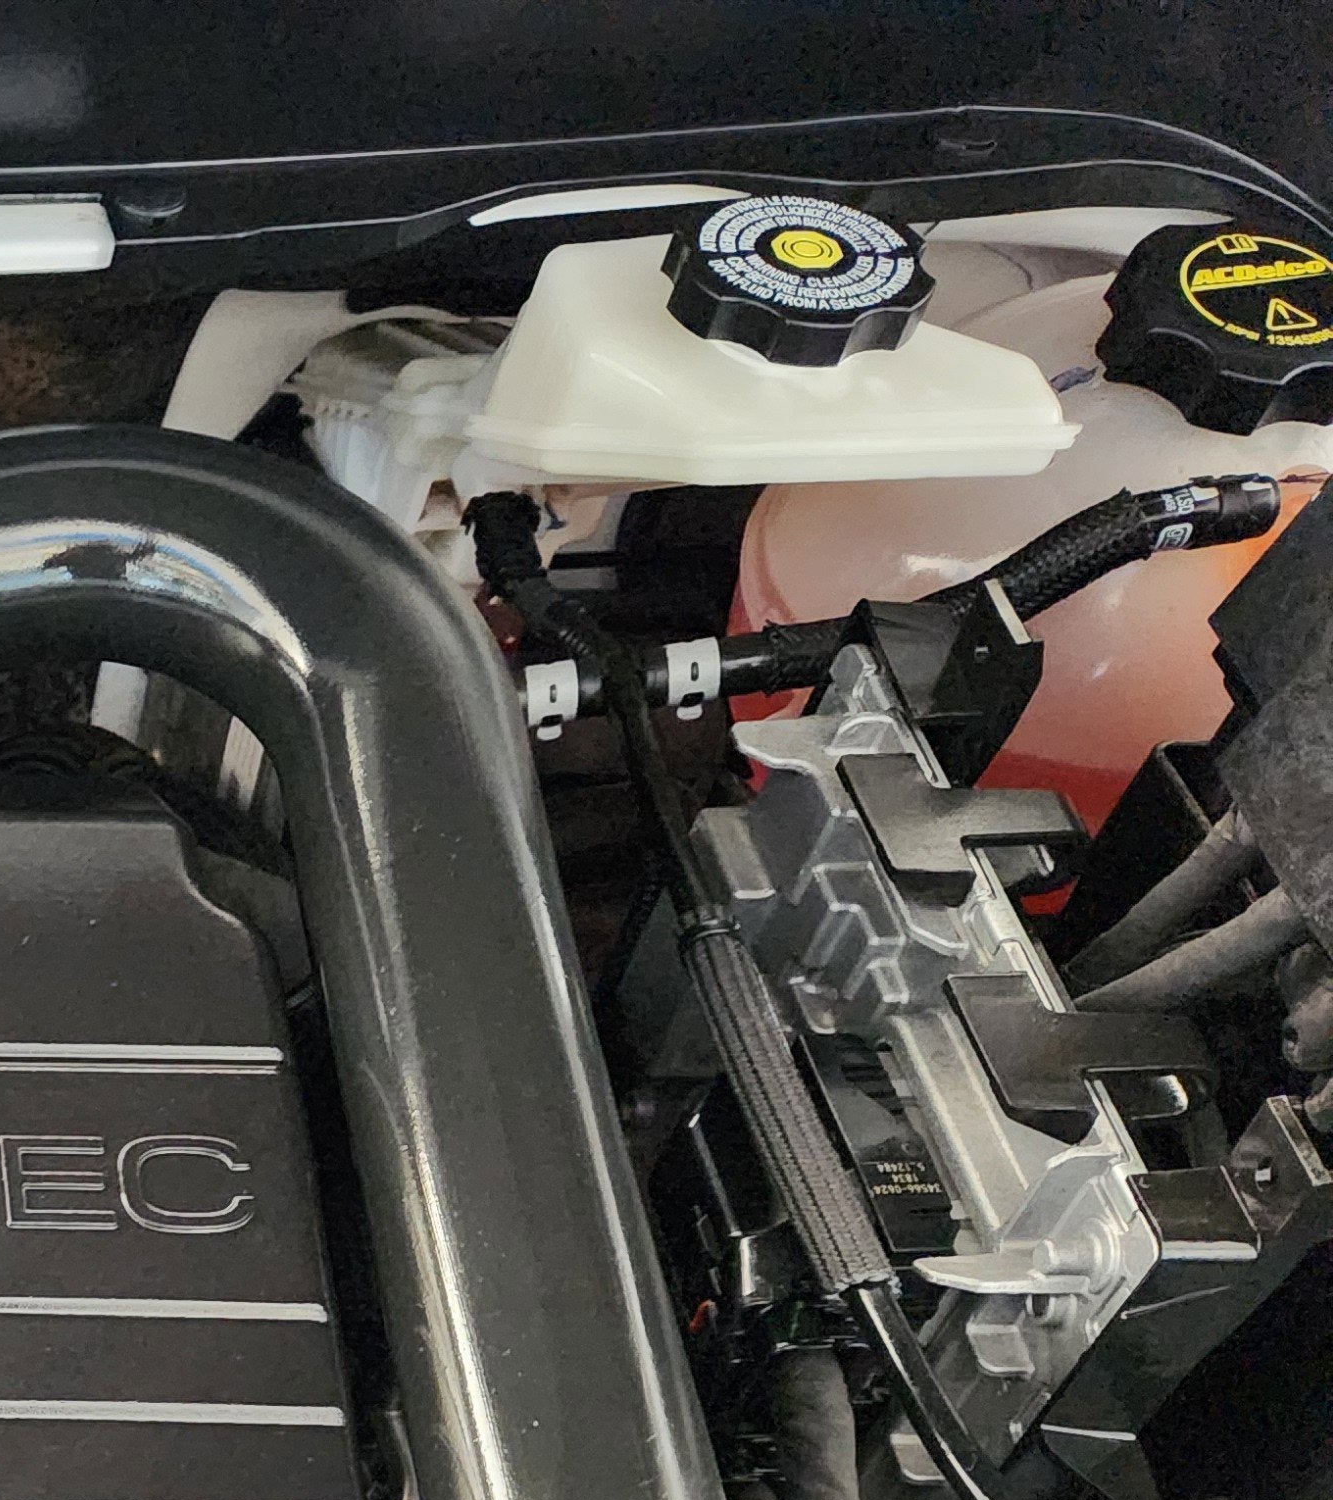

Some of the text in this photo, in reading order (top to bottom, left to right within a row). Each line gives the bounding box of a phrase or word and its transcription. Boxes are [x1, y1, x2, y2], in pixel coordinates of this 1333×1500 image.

[764, 195, 783, 206] LE
[782, 196, 840, 212] BOUCHON
[836, 205, 879, 225] AVANT
[764, 206, 784, 217] DU
[782, 206, 827, 219] LIQUIDE
[826, 211, 846, 223] DE
[840, 217, 876, 238] FREIN
[803, 216, 839, 232] BIDON
[726, 257, 753, 274] CAP
[744, 270, 797, 296] BEFORE
[807, 273, 854, 288] CLEAN
[1191, 260, 1327, 286] ACDelco
[733, 277, 774, 299] FLUID
[774, 292, 821, 309] FROM
[818, 299, 831, 310] A
[830, 291, 882, 311] SEALED
